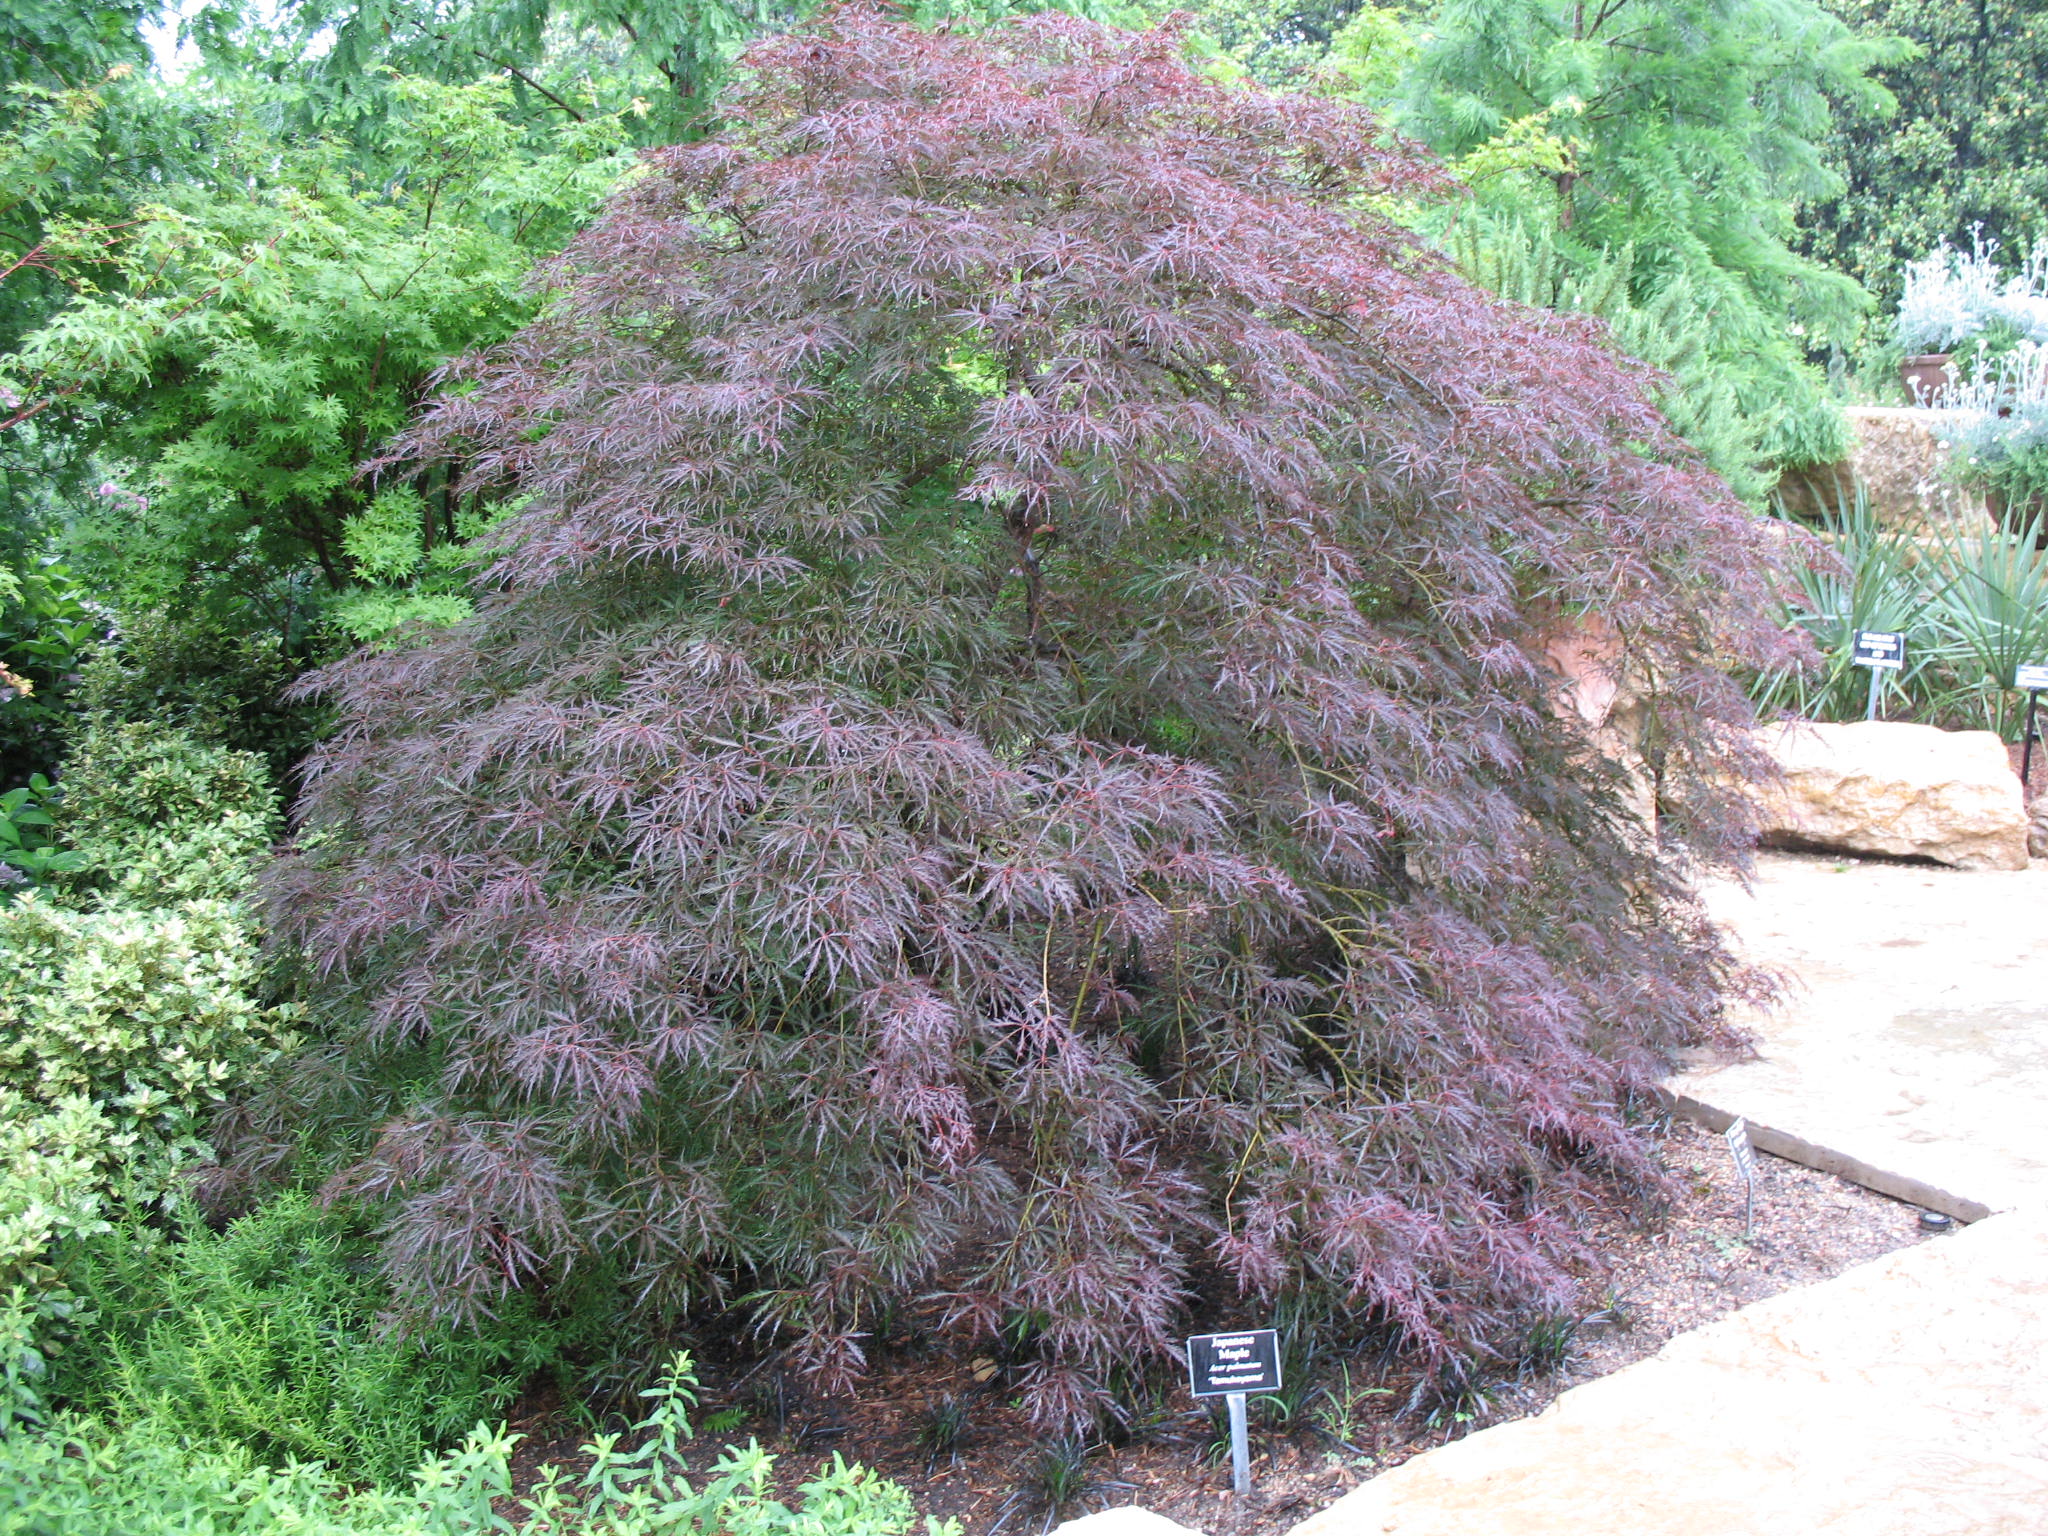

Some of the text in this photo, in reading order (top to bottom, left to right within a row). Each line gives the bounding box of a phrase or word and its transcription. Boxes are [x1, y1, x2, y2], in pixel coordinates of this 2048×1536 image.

[1211, 1336, 1255, 1349] Japanese
[1218, 1347, 1250, 1361] Maple
[1209, 1364, 1226, 1372] Acer
